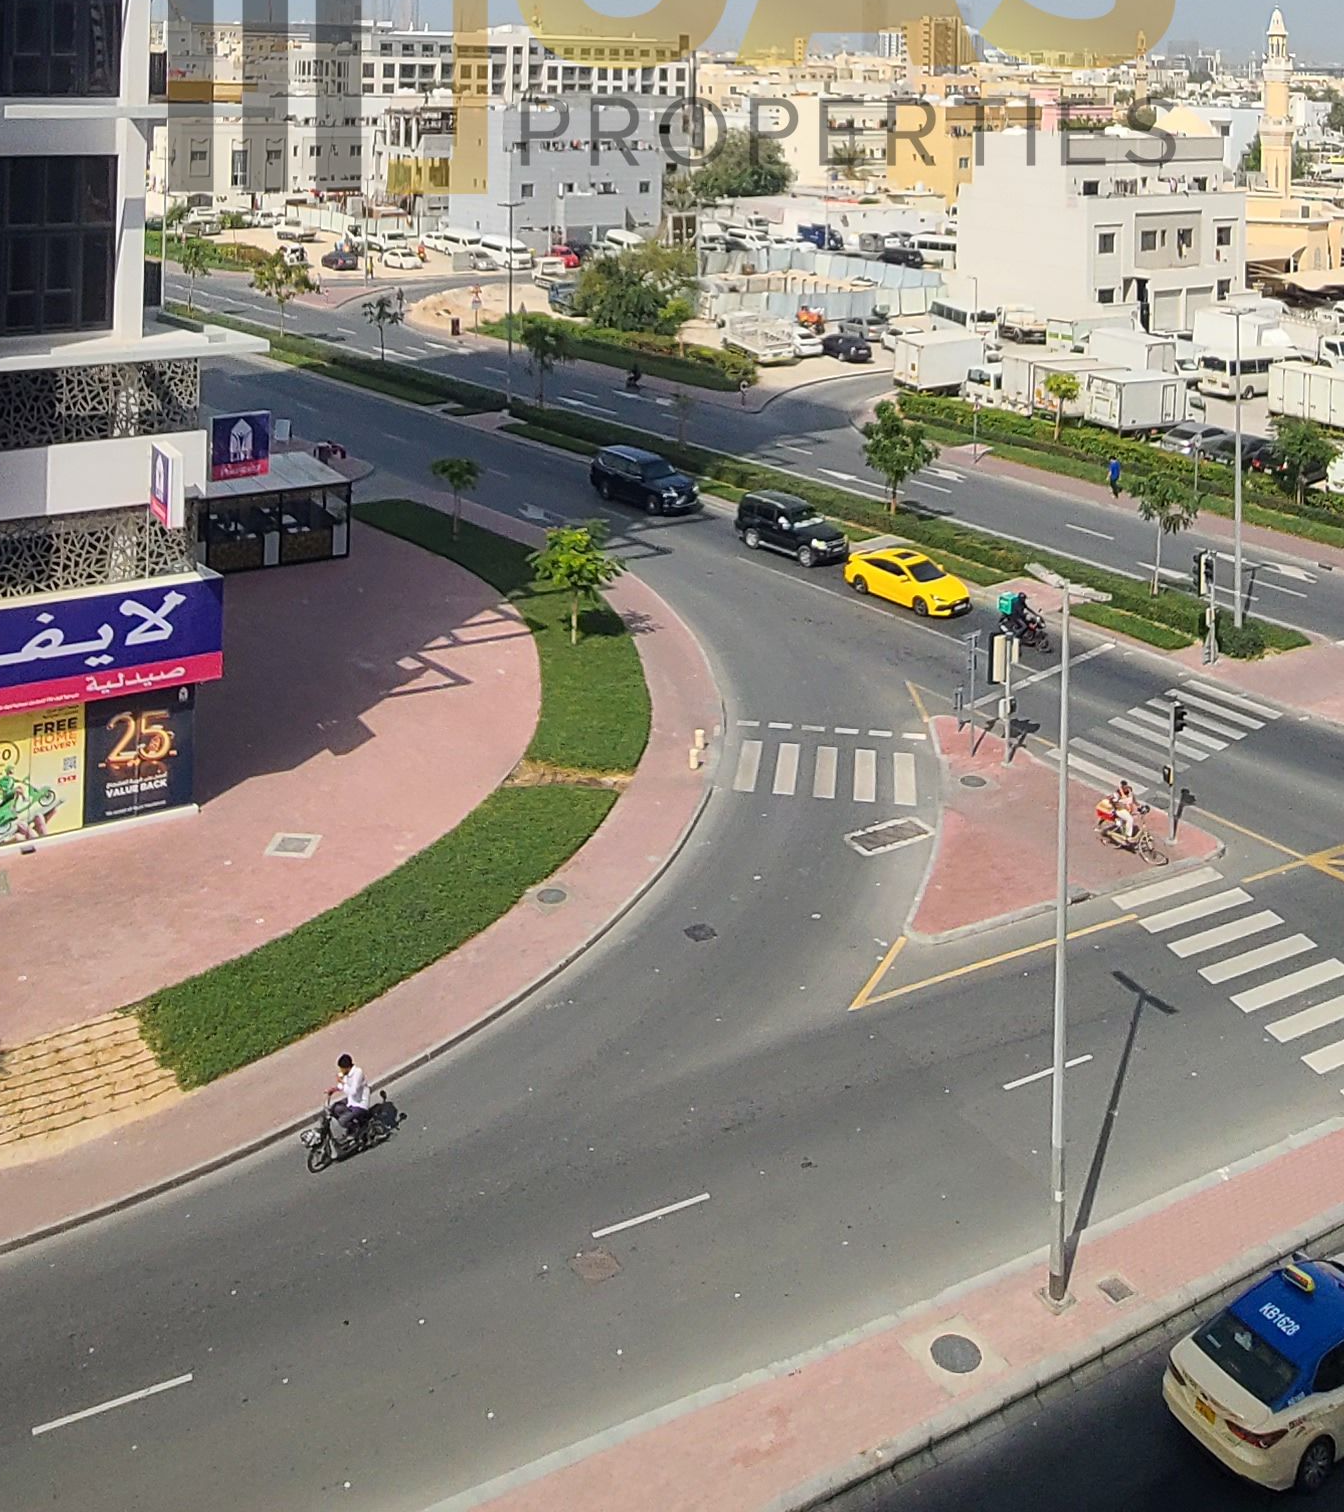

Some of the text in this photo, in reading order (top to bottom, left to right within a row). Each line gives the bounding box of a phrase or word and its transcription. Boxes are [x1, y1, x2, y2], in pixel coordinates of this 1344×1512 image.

[85, 665, 185, 694] صيدلية
[33, 717, 78, 736] FREE
[107, 708, 173, 763] 25
[33, 731, 78, 747] HOME
[33, 741, 77, 754] DELIVERY
[106, 783, 139, 798] VALUE
[140, 778, 168, 792] BACK
[1259, 1302, 1300, 1336] KB1628
